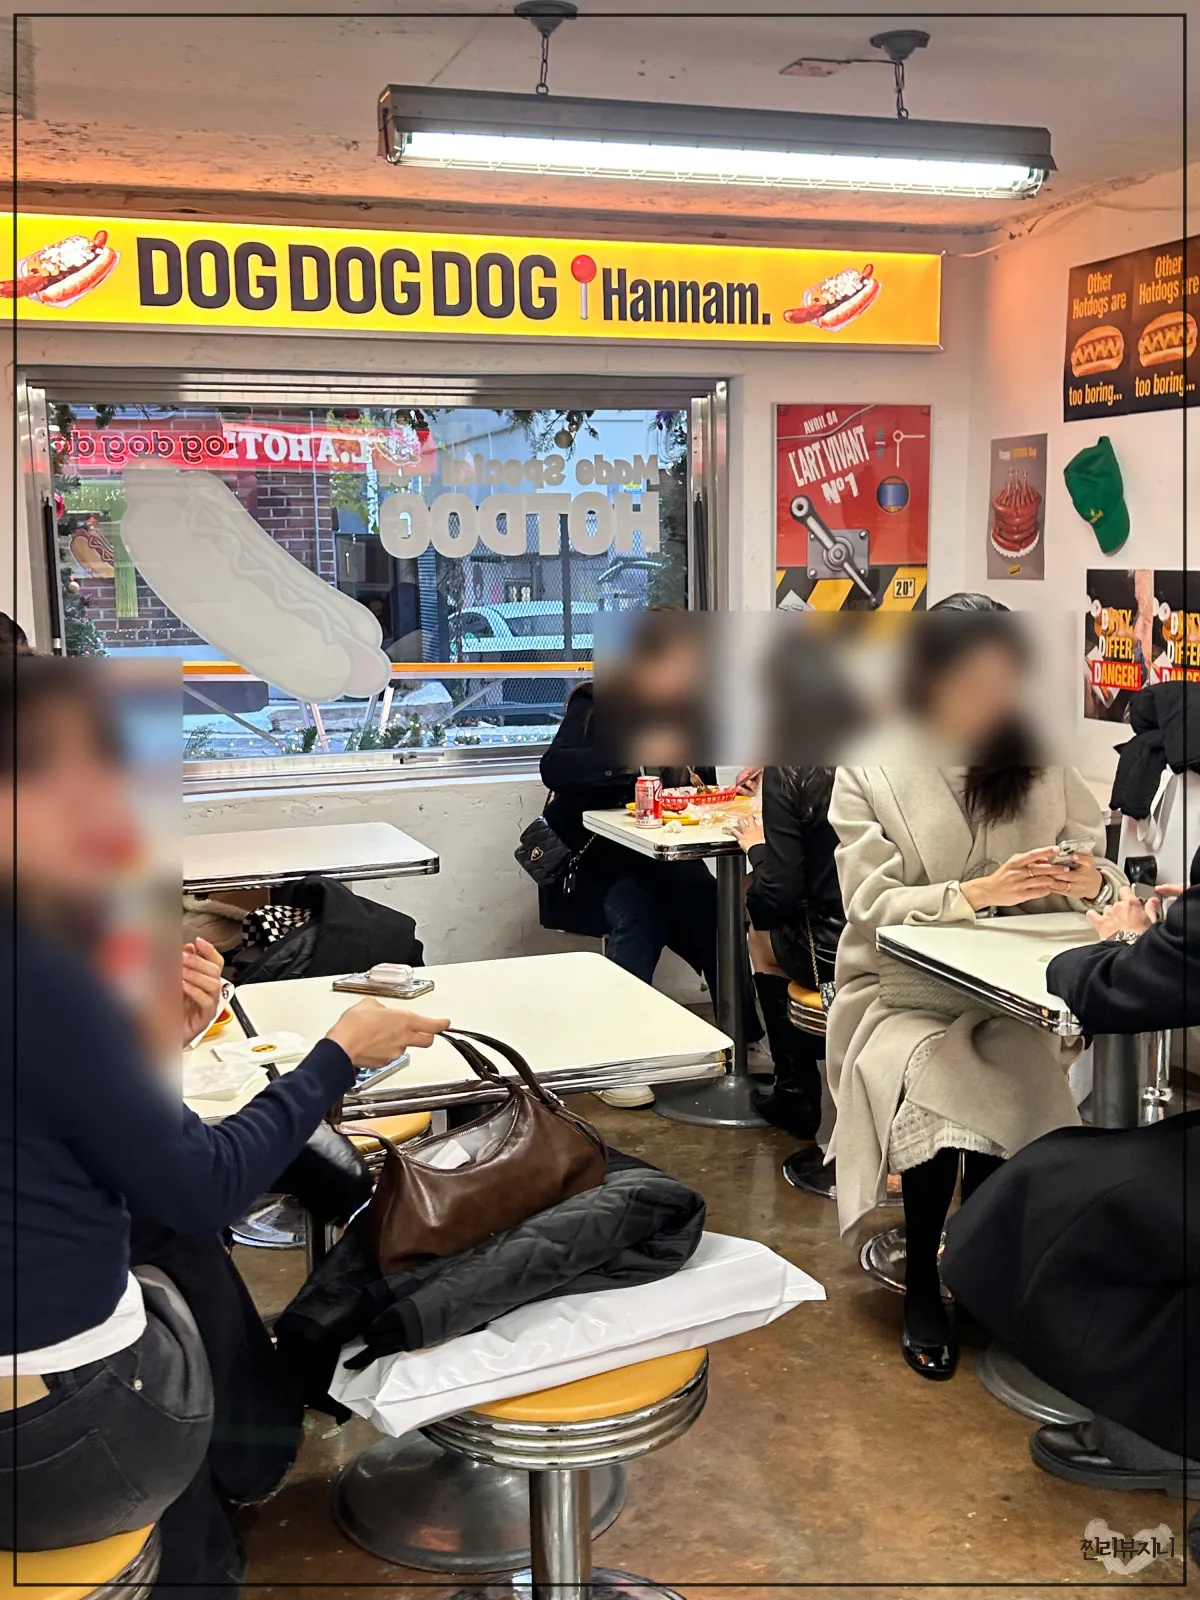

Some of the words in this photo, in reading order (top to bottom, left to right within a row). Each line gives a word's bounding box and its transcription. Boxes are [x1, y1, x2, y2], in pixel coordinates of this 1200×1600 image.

[137, 237, 277, 310] DOG
[288, 244, 421, 316] DOG
[432, 250, 557, 320] DOG
[602, 268, 771, 325] Hannam.
[1087, 272, 1113, 294] Other
[1139, 280, 1179, 305] Hotdogs
[1182, 275, 1200, 295] re
[1072, 296, 1109, 319] Hotdogs
[1111, 292, 1127, 311] are
[1069, 386, 1083, 406] too
[1085, 381, 1123, 406] boring...
[1135, 376, 1151, 397] too
[803, 415, 828, 435] AVRIL
[826, 410, 839, 426] 84
[788, 441, 827, 488] L'ART
[821, 425, 870, 474] VIVANT
[1094, 662, 1139, 688] DANGER!
